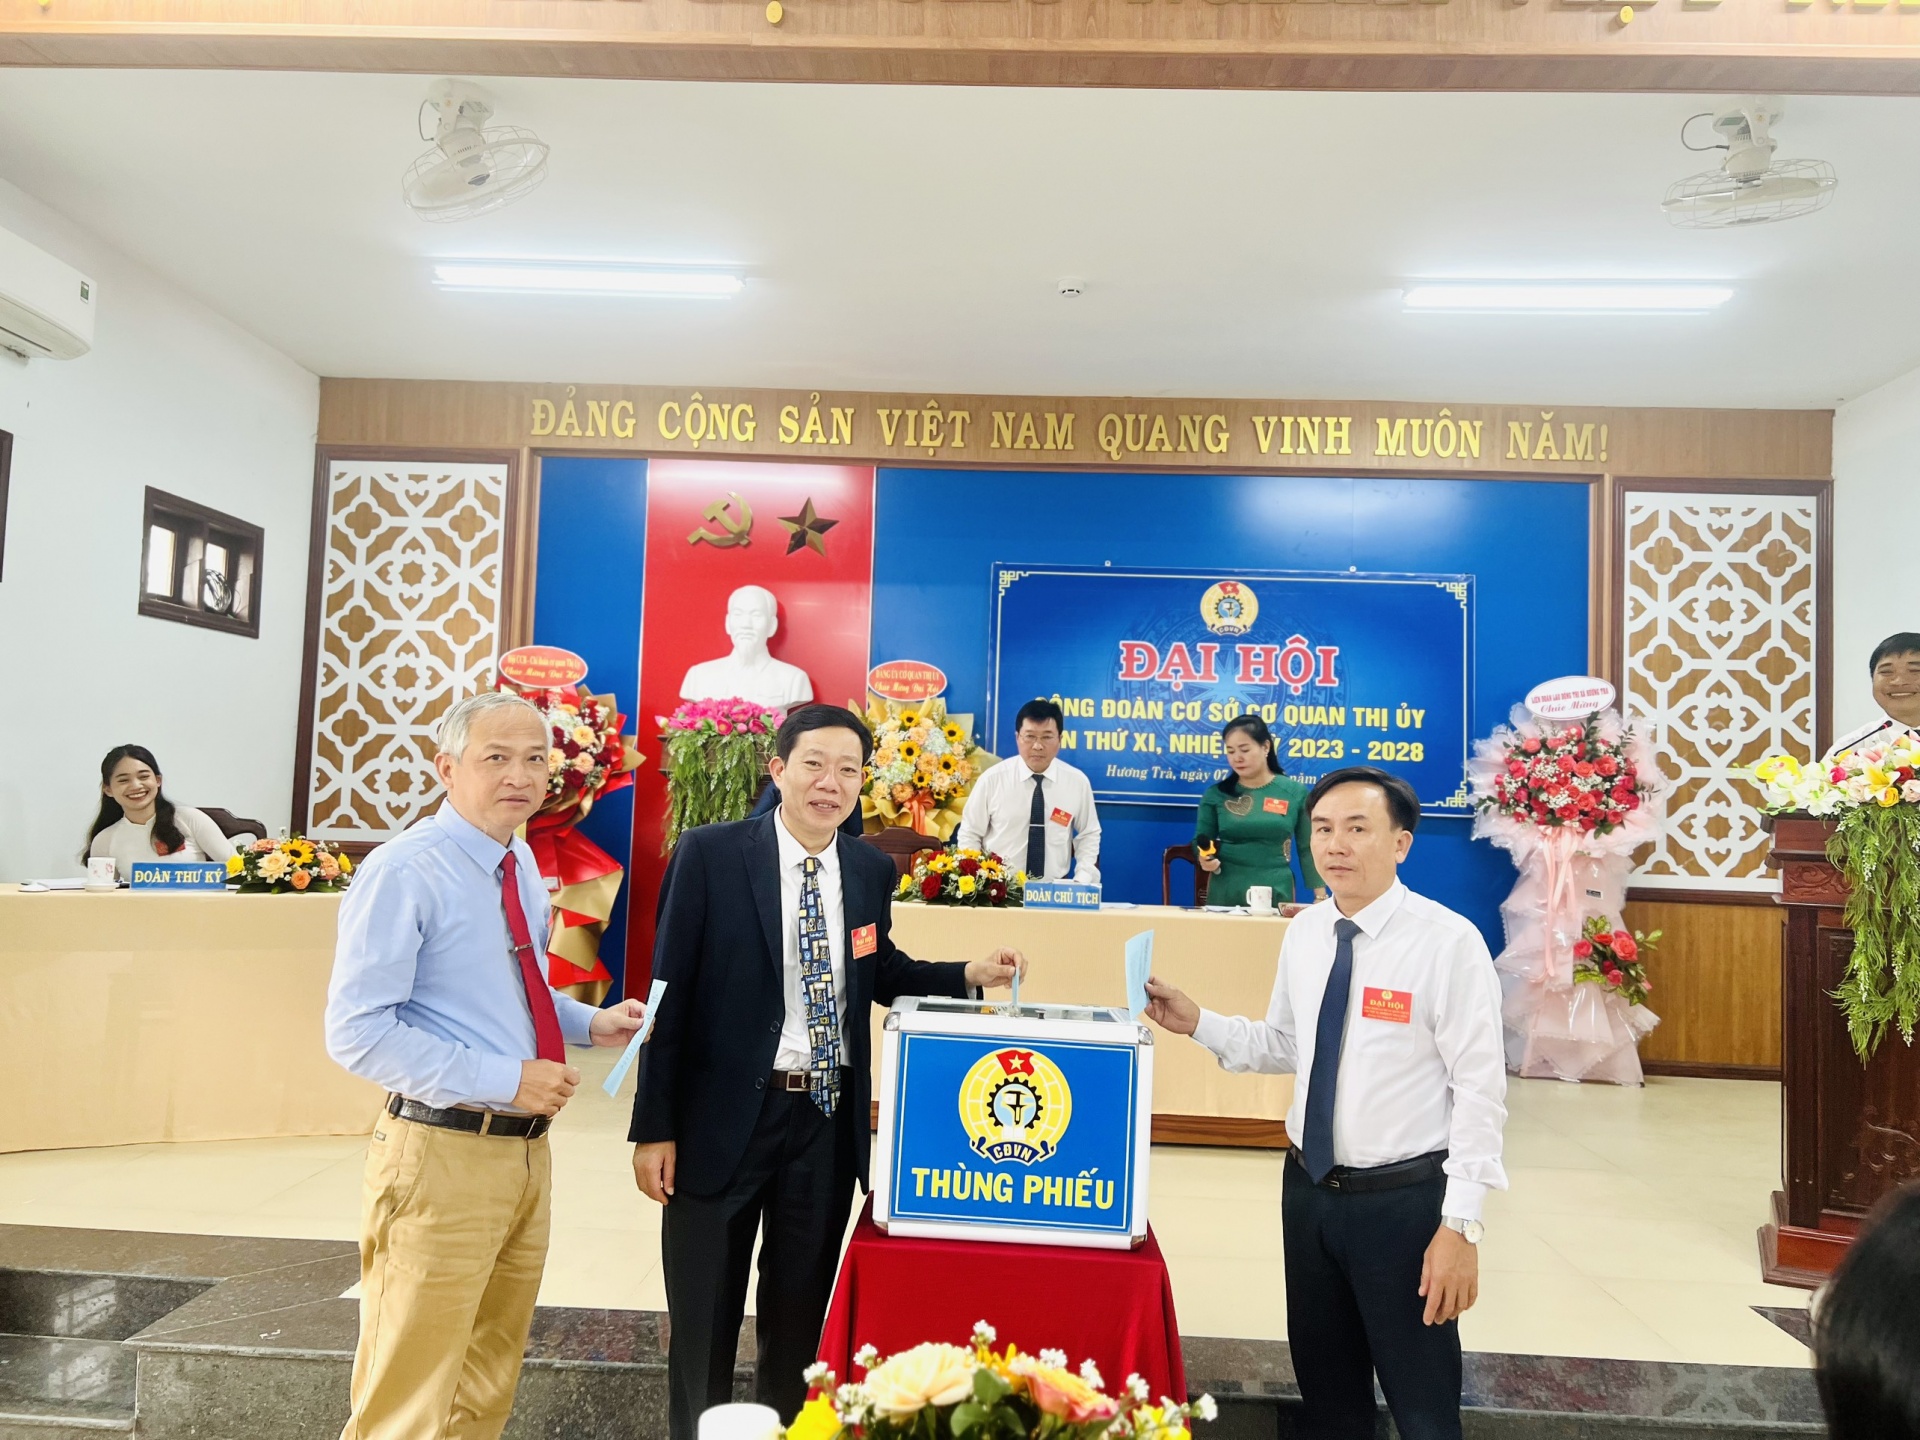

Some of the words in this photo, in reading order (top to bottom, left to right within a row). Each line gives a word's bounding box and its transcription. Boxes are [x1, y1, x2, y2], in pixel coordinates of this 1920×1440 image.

[531, 385, 636, 438] ĐẢNG
[658, 391, 757, 449] CỘNG
[778, 392, 855, 445] SẢN
[877, 399, 971, 457] VIỆT
[990, 411, 1076, 450] NAM
[1098, 413, 1230, 461] QUANG
[1251, 416, 1352, 454] VINH
[1374, 407, 1483, 459] MUÔN
[1505, 410, 1609, 462] NĂM!
[1119, 640, 1220, 692] ĐẠI
[1235, 634, 1339, 695] HỘI
[1102, 696, 1163, 720] ĐOÀN
[1170, 701, 1202, 722] CƠ
[1208, 697, 1239, 723] SỞ
[1284, 705, 1345, 728] QUAN
[1352, 707, 1388, 731] THỊ
[1396, 702, 1425, 729] ỦY
[1084, 728, 1129, 751] THỨ
[1133, 733, 1162, 755] XI,
[1170, 731, 1228, 759] NHIỆ
[1288, 738, 1345, 759] 2023
[1367, 740, 1424, 762] 2028
[1106, 764, 1148, 781] Hương
[1151, 765, 1176, 781] Trà,
[1180, 768, 1211, 783] ngày
[134, 867, 171, 883] ĐOÀN
[175, 868, 203, 883] THƯ
[204, 868, 224, 883] KÝ
[1026, 887, 1052, 902] ĐOÀN
[1054, 887, 1073, 903] CHỦ
[1076, 892, 1099, 906] TỊCH
[993, 1143, 1033, 1161] CĐVN
[911, 1161, 1014, 1204] THÙNG
[1023, 1167, 1115, 1210] PHIẾU
